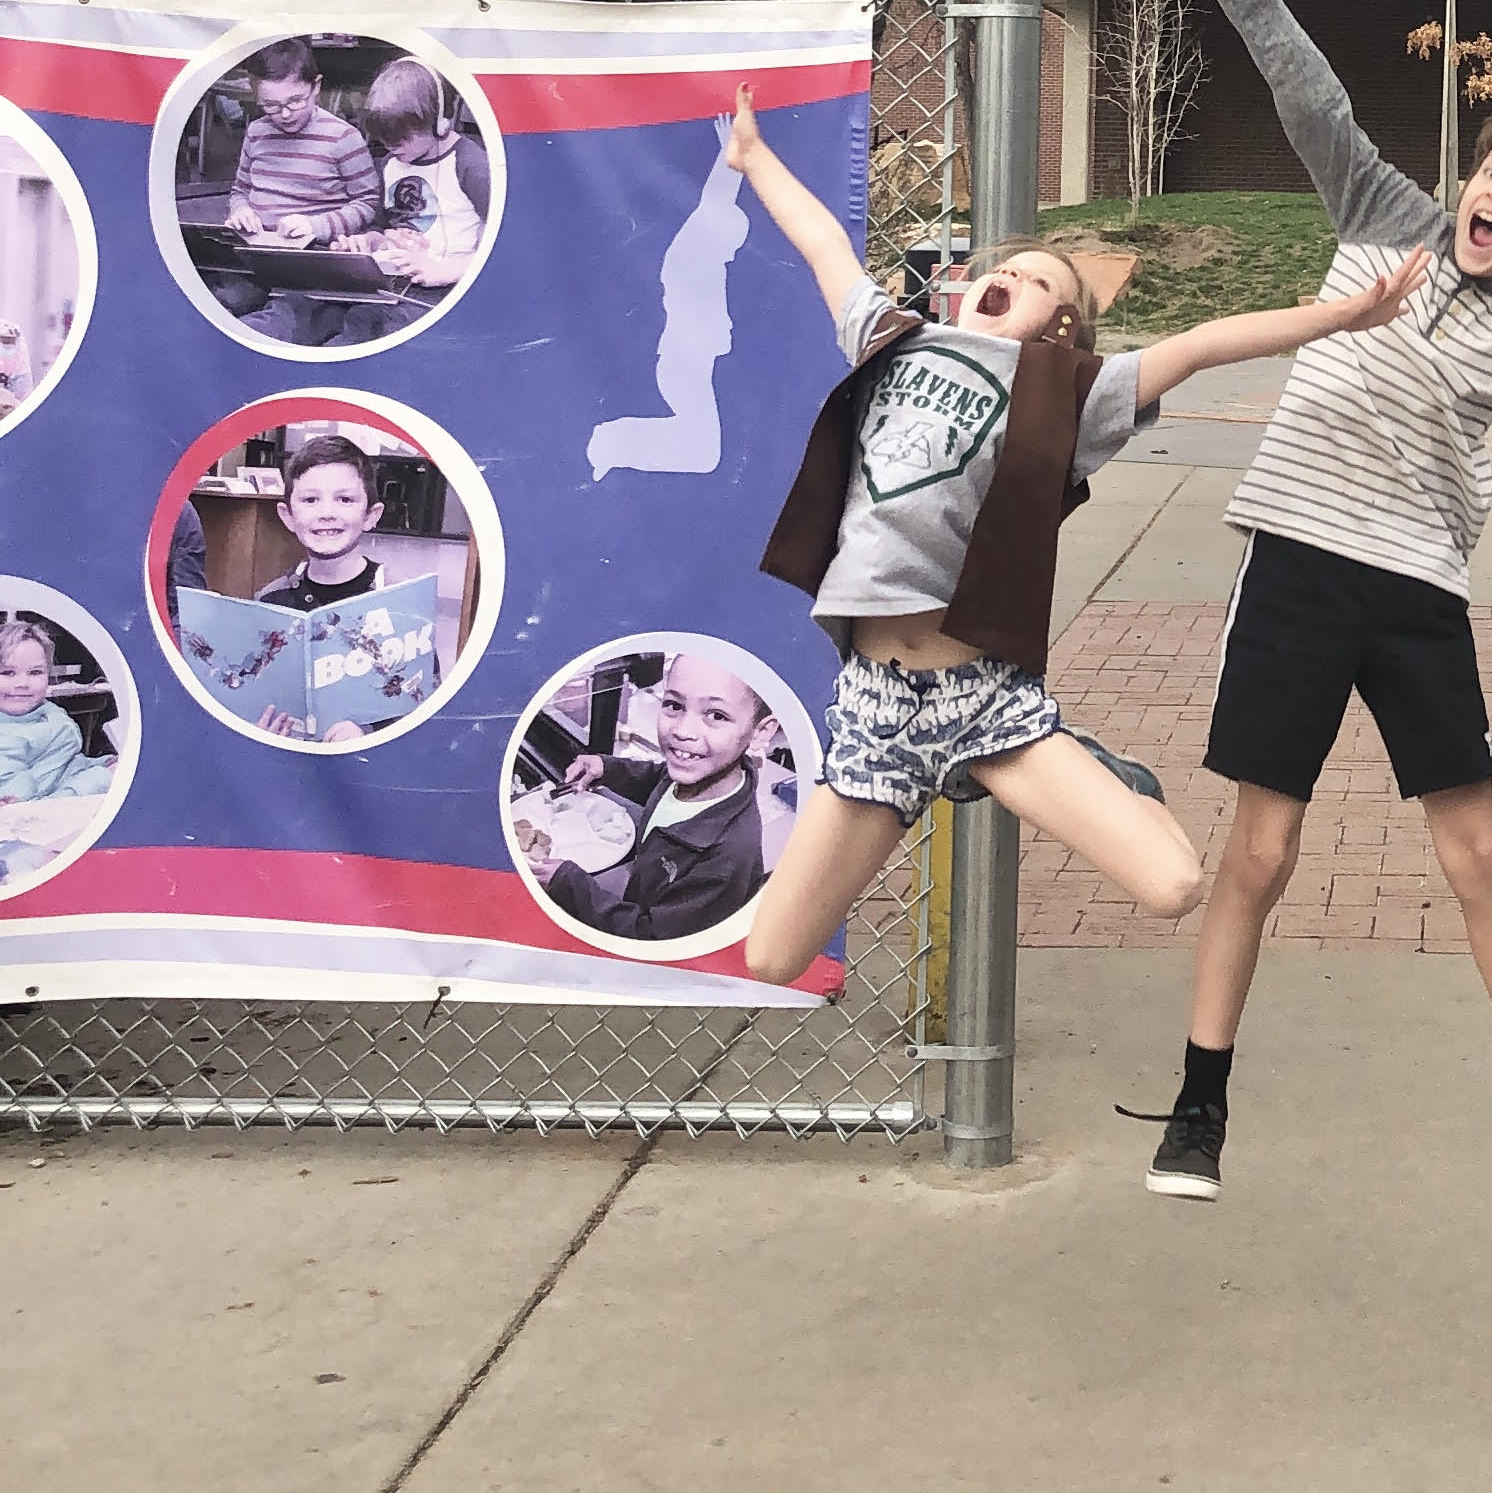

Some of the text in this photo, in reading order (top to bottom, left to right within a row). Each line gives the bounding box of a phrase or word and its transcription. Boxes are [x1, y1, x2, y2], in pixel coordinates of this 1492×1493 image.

[880, 359, 993, 420] SLAVENS
[361, 608, 395, 637] A
[314, 623, 433, 690] BOOK
